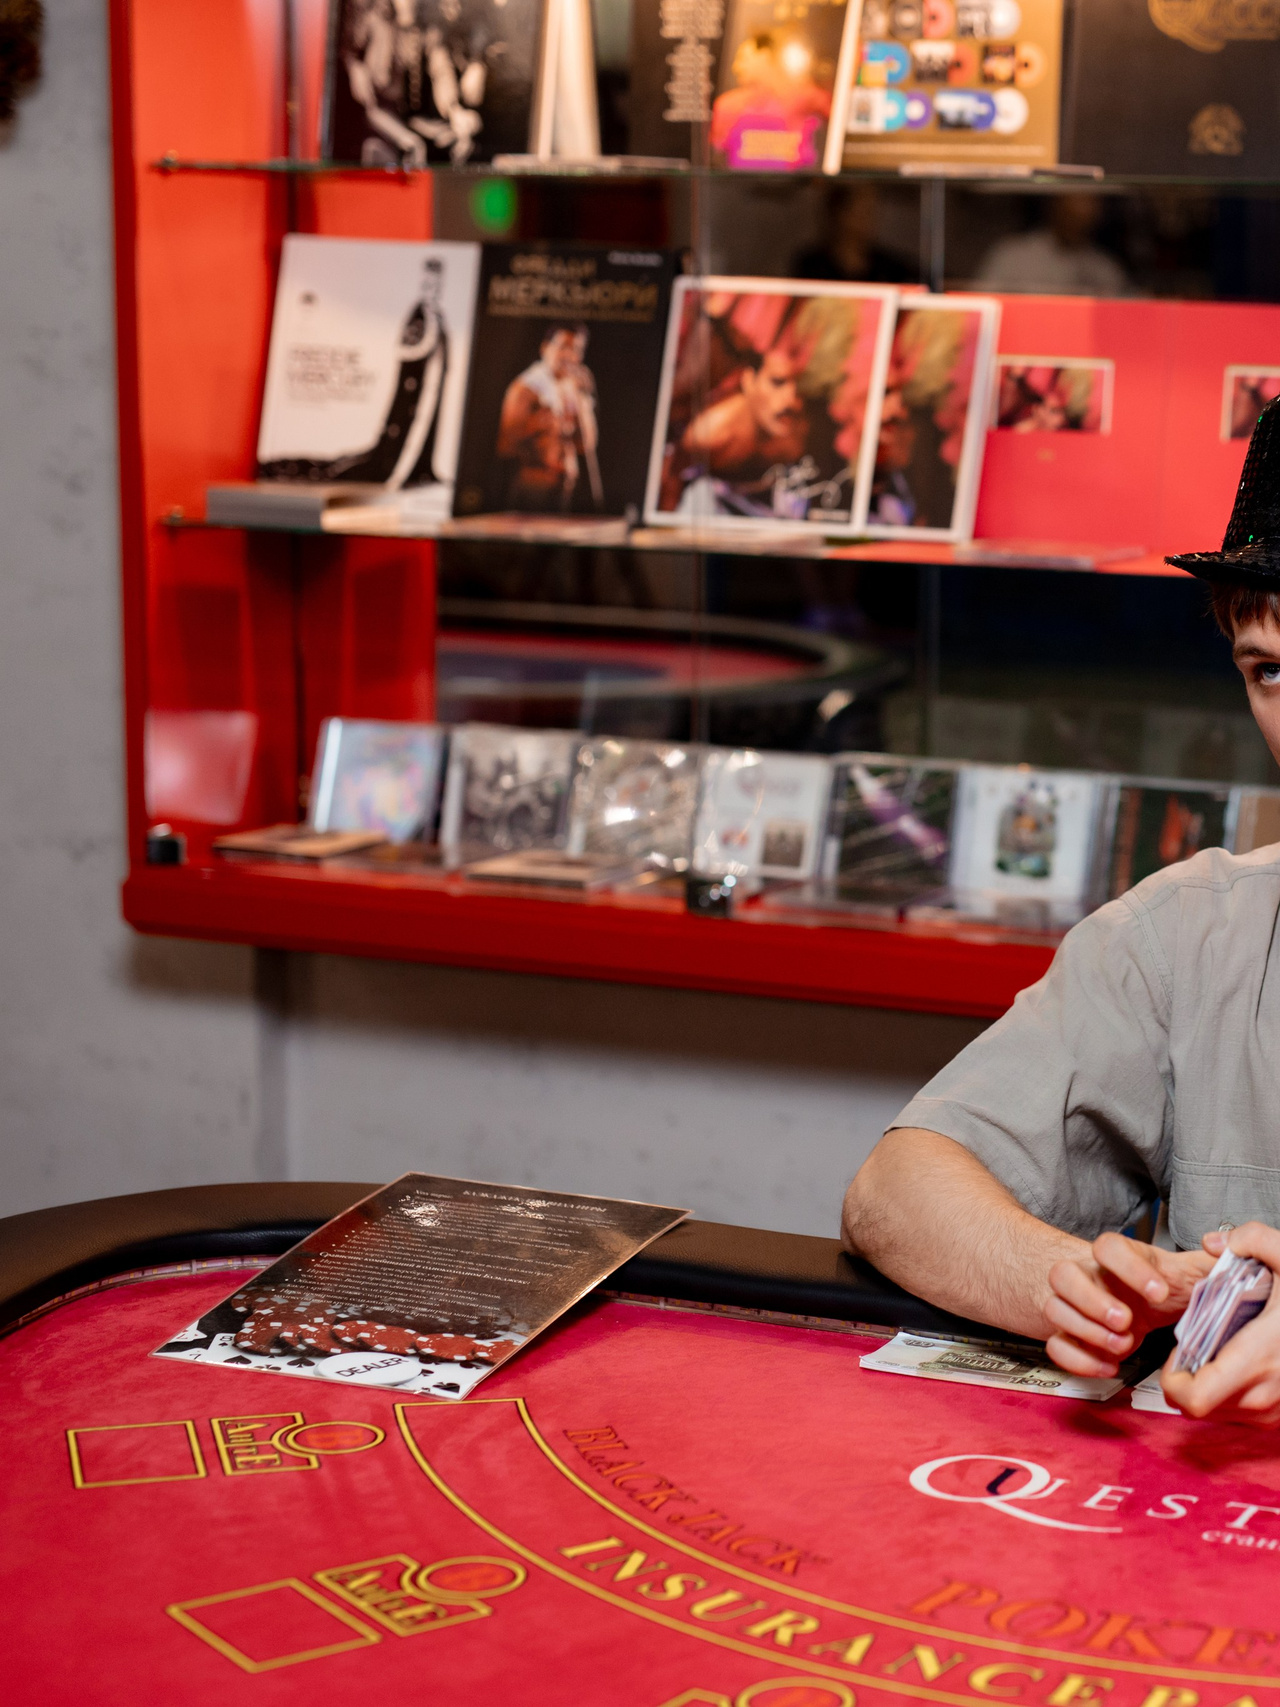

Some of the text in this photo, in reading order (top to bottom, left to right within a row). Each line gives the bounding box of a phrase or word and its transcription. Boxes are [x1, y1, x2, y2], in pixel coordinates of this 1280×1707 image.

[335, 1356, 408, 1377] DEALER
[1008, 1375, 1062, 1389] 100
[562, 1424, 803, 1576] BLACK JACK
[558, 1535, 1119, 1707] INSURANCE
